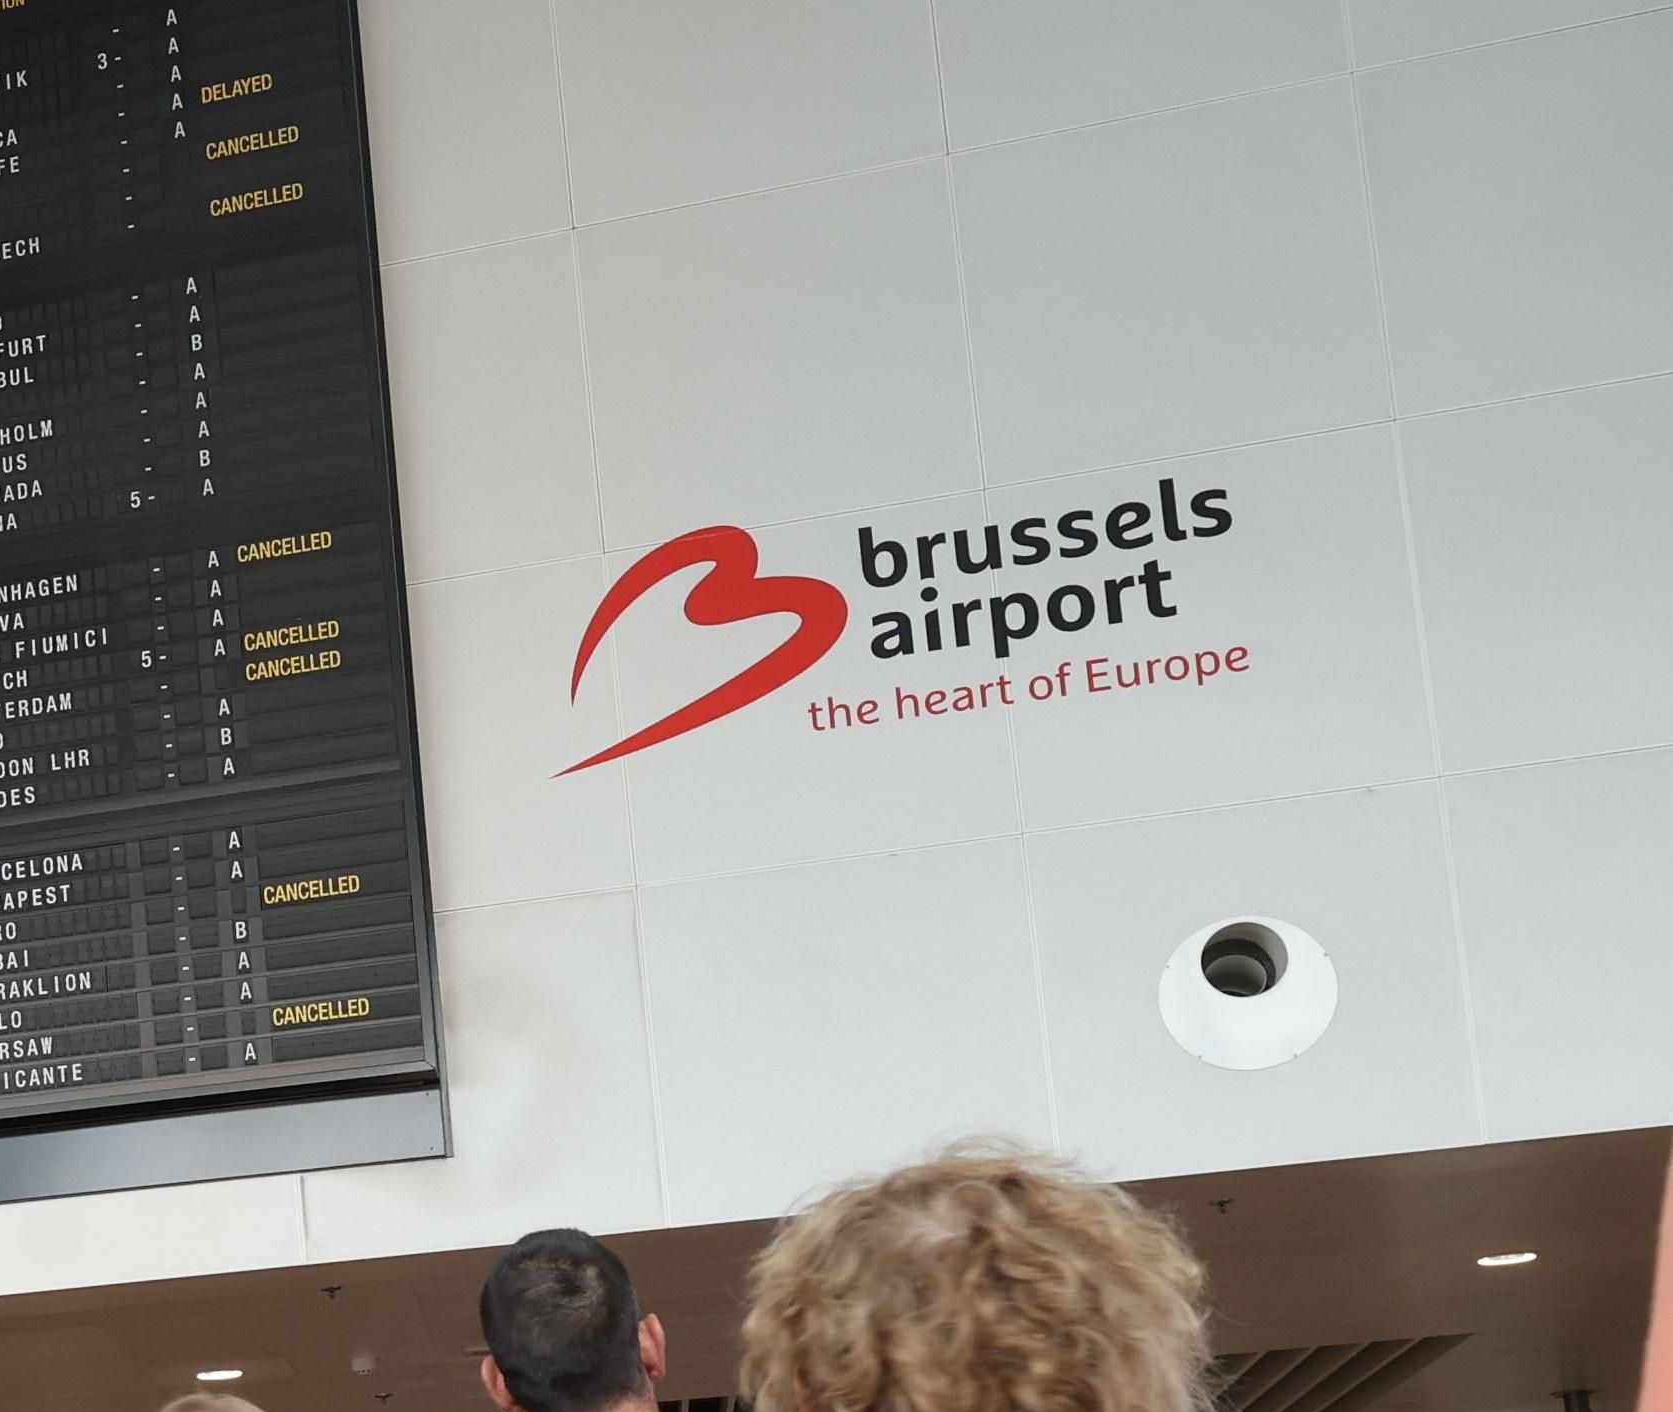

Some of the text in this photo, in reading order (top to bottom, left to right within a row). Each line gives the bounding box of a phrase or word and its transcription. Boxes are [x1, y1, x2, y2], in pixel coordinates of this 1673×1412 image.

[201, 73, 273, 104] DELAYED
[205, 125, 299, 160] CANCELLED
[209, 182, 304, 217] CANCELLED
[237, 531, 332, 563] CANCELLED
[857, 477, 1234, 588] brussels
[869, 559, 1179, 660] airport
[243, 620, 340, 652] CANCELLED
[245, 650, 341, 681] CANCELLED
[807, 646, 1251, 731] the heart of Europe
[50, 748, 90, 771] LHR
[263, 874, 360, 905] CANCELLED
[272, 997, 370, 1026] CANCELLED
